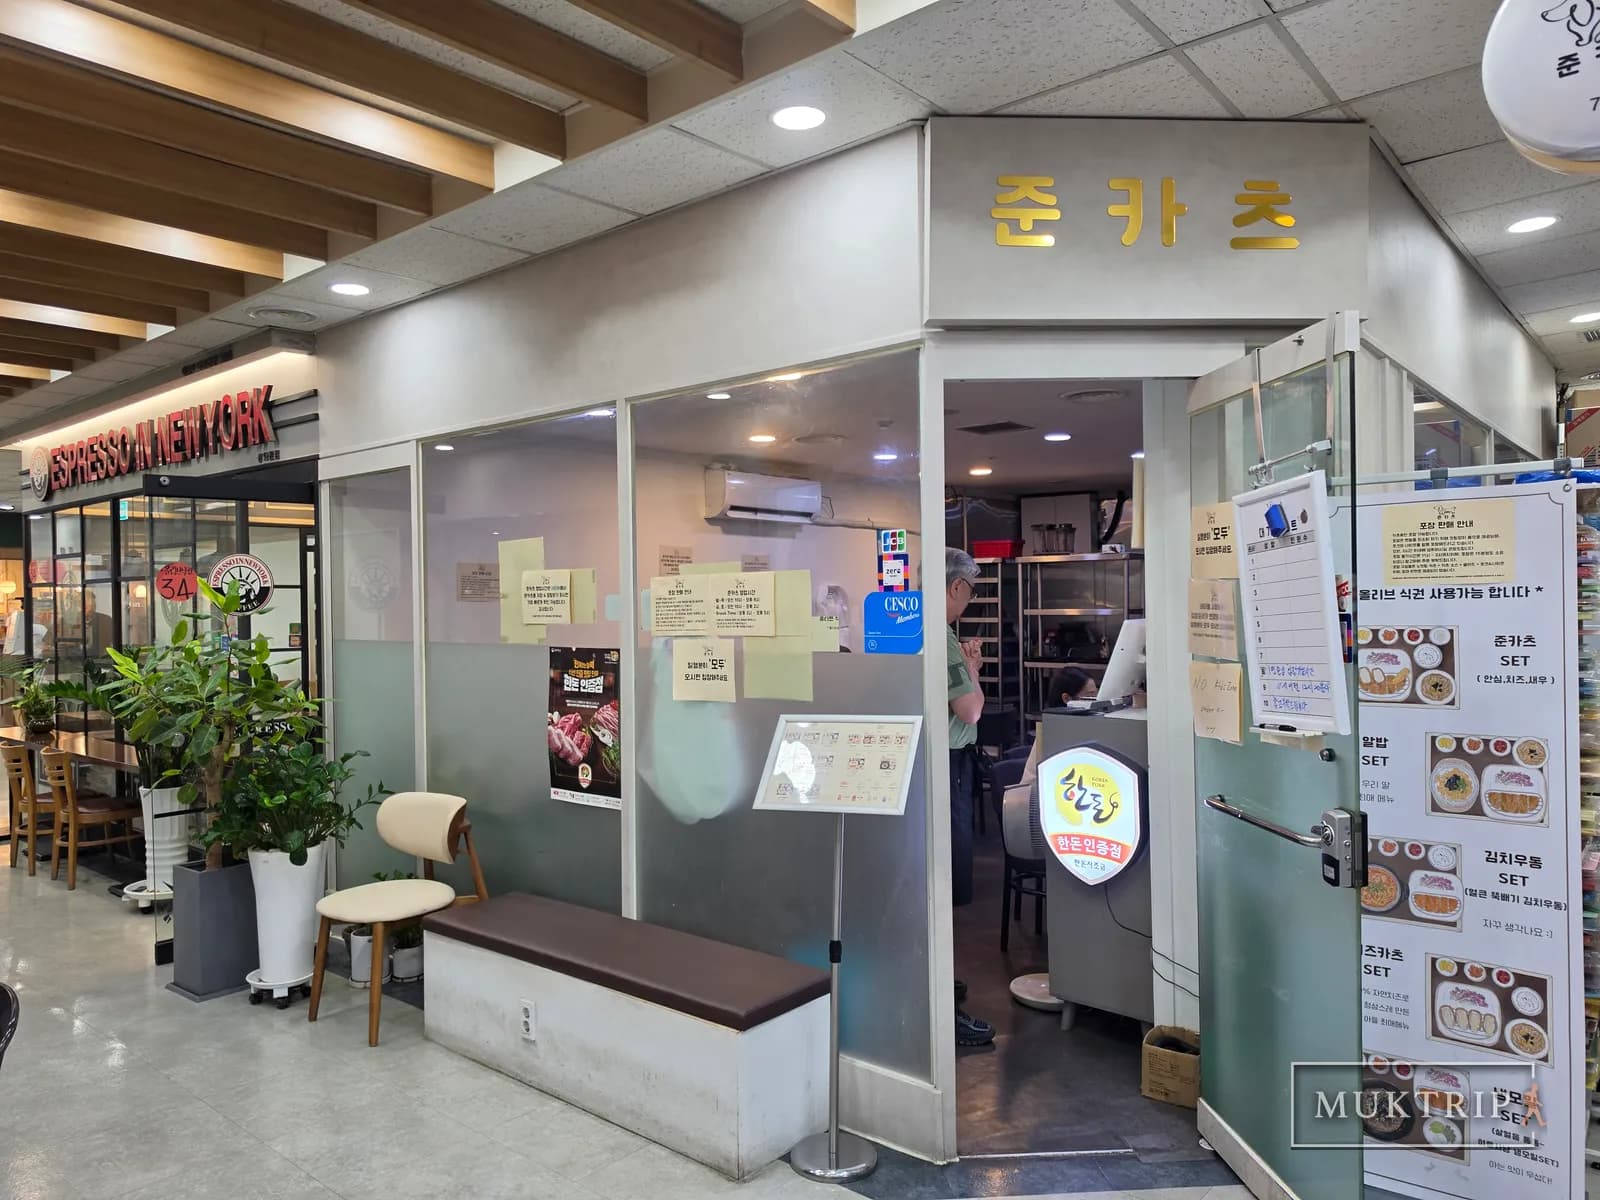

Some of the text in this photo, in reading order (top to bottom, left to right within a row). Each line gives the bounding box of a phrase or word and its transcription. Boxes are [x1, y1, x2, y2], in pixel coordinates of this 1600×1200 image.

[50, 426, 131, 491] ESPRESSO
[135, 419, 155, 472] IN
[156, 385, 276, 466] NEWYORK
[1457, 520, 1474, 528] 안내
[882, 537, 905, 546] JCB
[1400, 587, 1425, 600] 식권
[1429, 587, 1485, 600] 사용가능
[1488, 586, 1531, 598] 합니다
[884, 596, 919, 611] CESCO
[1493, 634, 1537, 648] 준카츠
[1500, 655, 1531, 667] SET
[1361, 736, 1389, 748] 알밥
[1361, 755, 1390, 767] SET
[1361, 779, 1379, 789] 우리
[1377, 794, 1394, 804] 메뉴
[1484, 851, 1543, 870] 김치우동
[1499, 873, 1529, 887] SET
[1482, 918, 1502, 930] 자꾸
[1505, 922, 1543, 938] 생각나요
[1360, 944, 1404, 961] 즈카츠
[1363, 965, 1391, 978] SET
